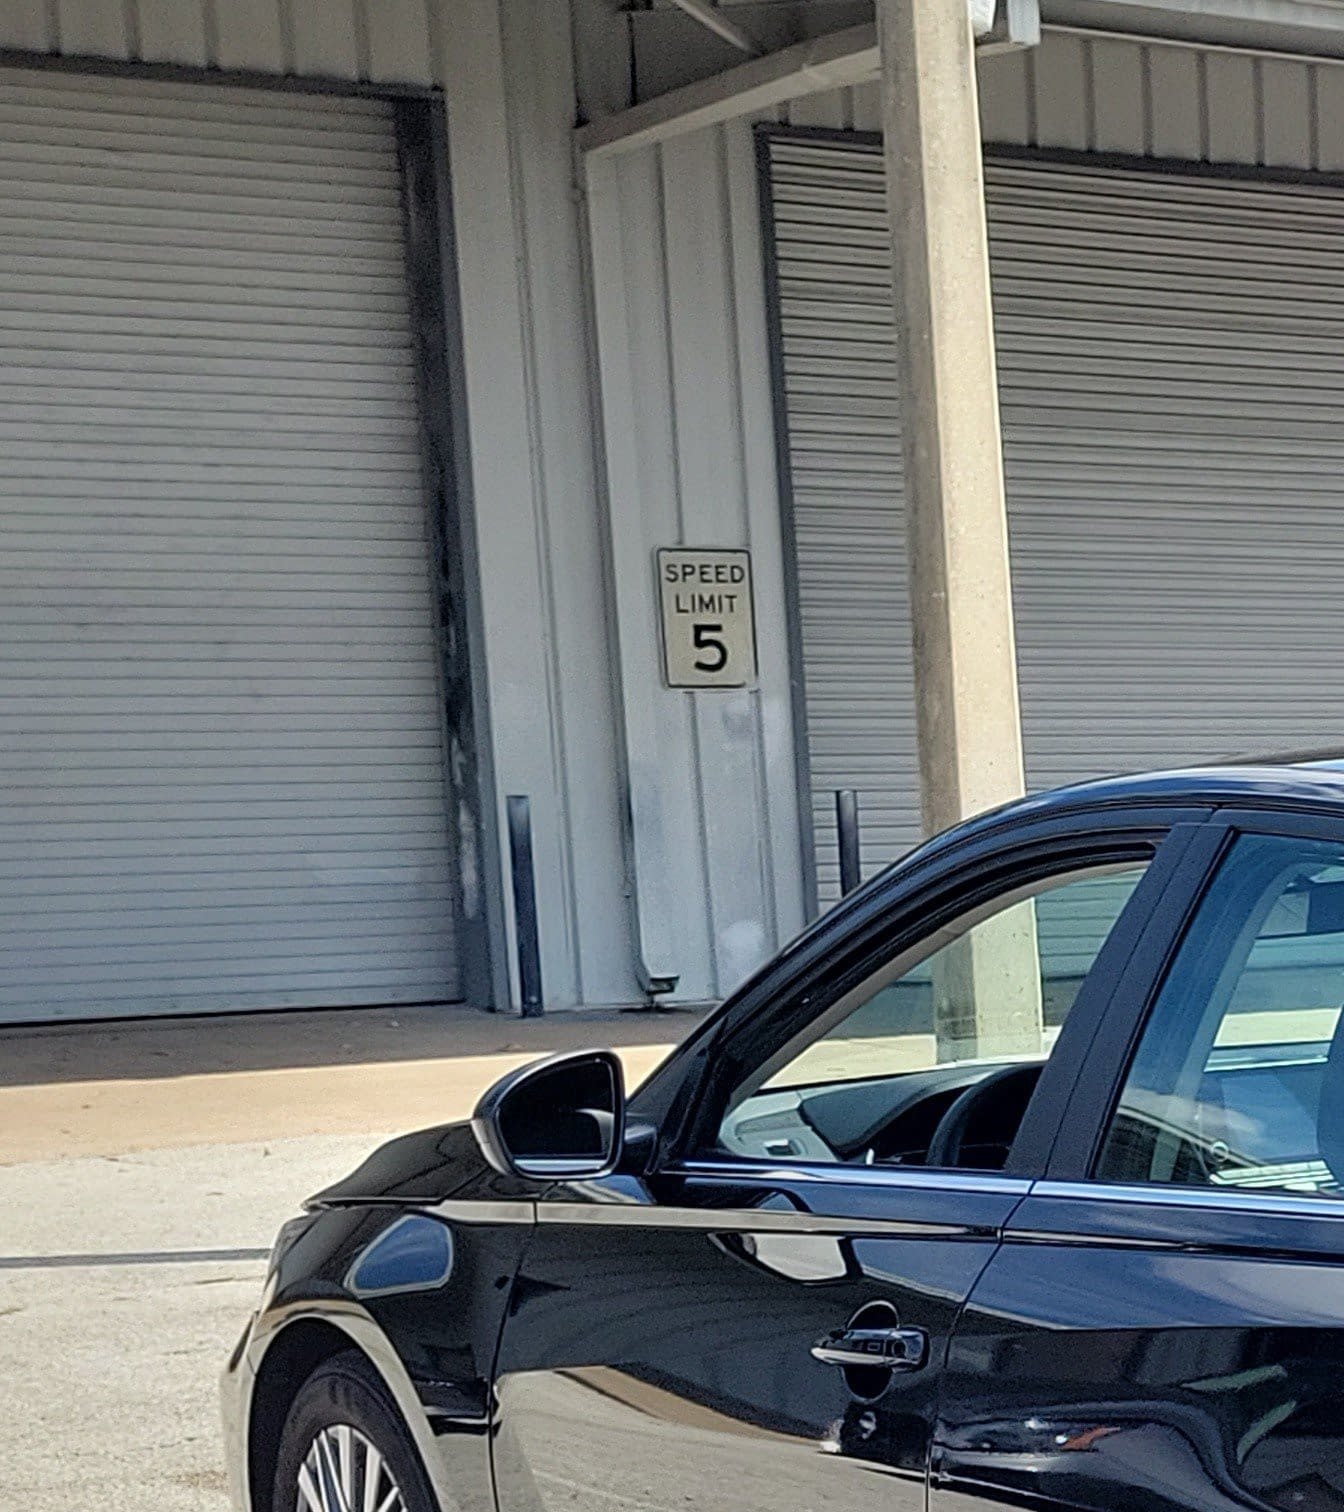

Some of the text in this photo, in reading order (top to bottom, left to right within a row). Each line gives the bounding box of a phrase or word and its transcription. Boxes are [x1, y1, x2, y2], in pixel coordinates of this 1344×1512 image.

[665, 563, 745, 584] SPEED
[675, 593, 737, 613] LIMIT
[693, 623, 728, 672] 5
